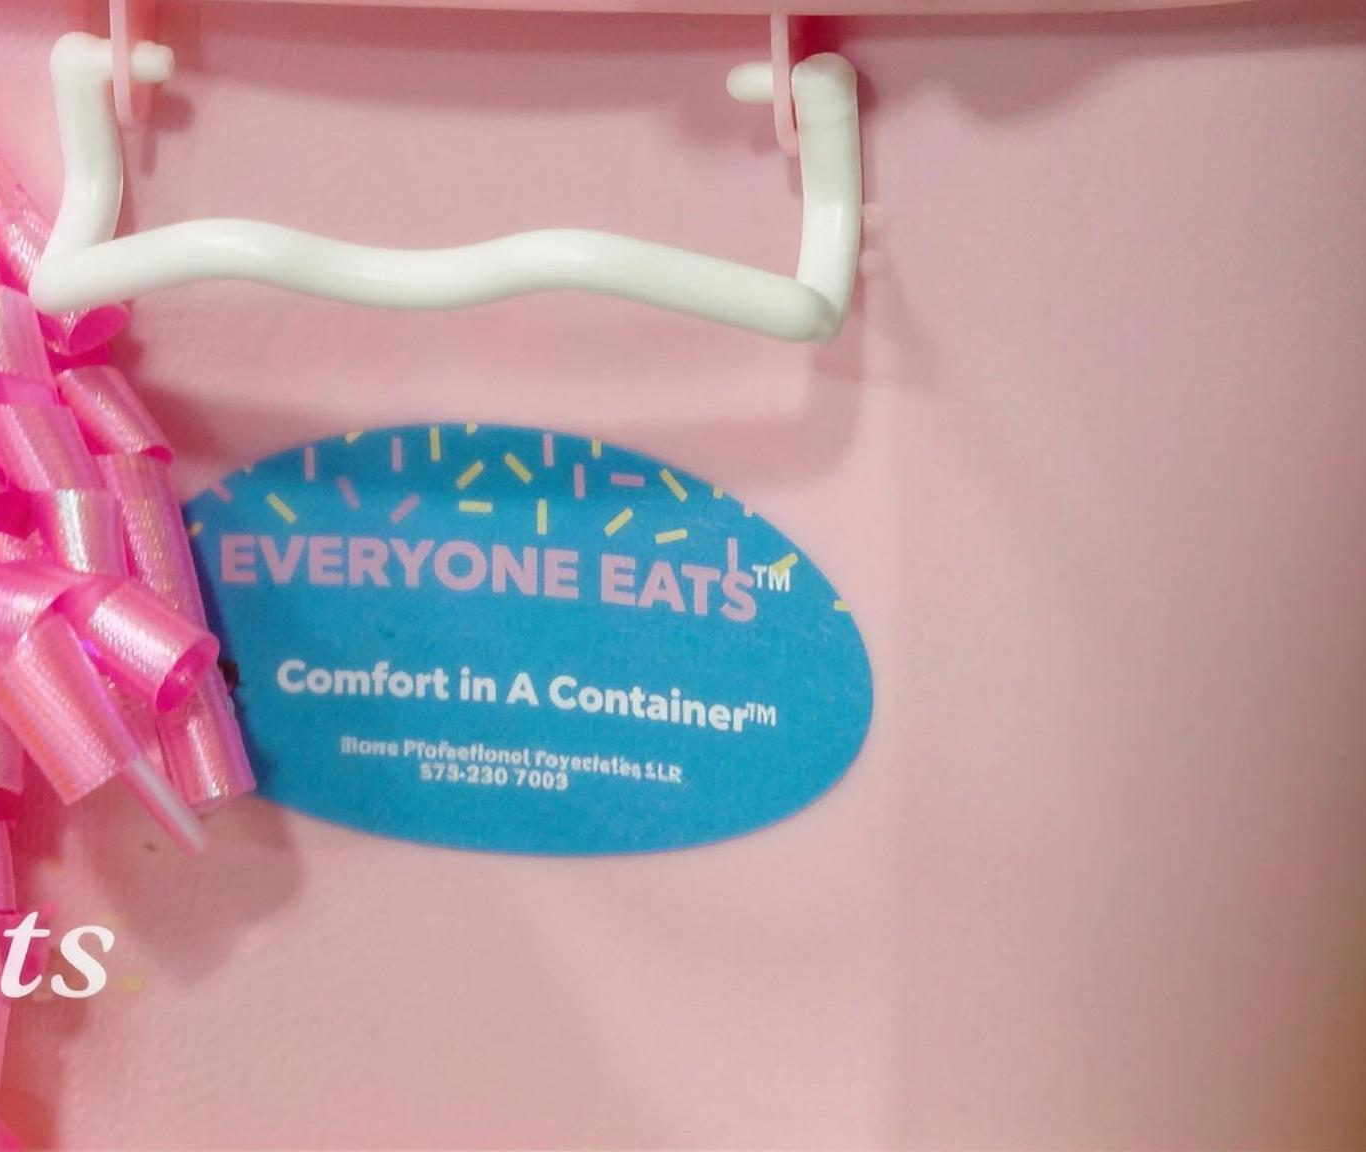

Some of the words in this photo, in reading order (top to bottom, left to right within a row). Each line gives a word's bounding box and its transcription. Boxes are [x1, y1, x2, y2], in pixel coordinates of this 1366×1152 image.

[220, 534, 579, 600] EVERYONE
[277, 659, 450, 701] Comfort
[459, 666, 497, 703] in
[506, 671, 540, 706] A
